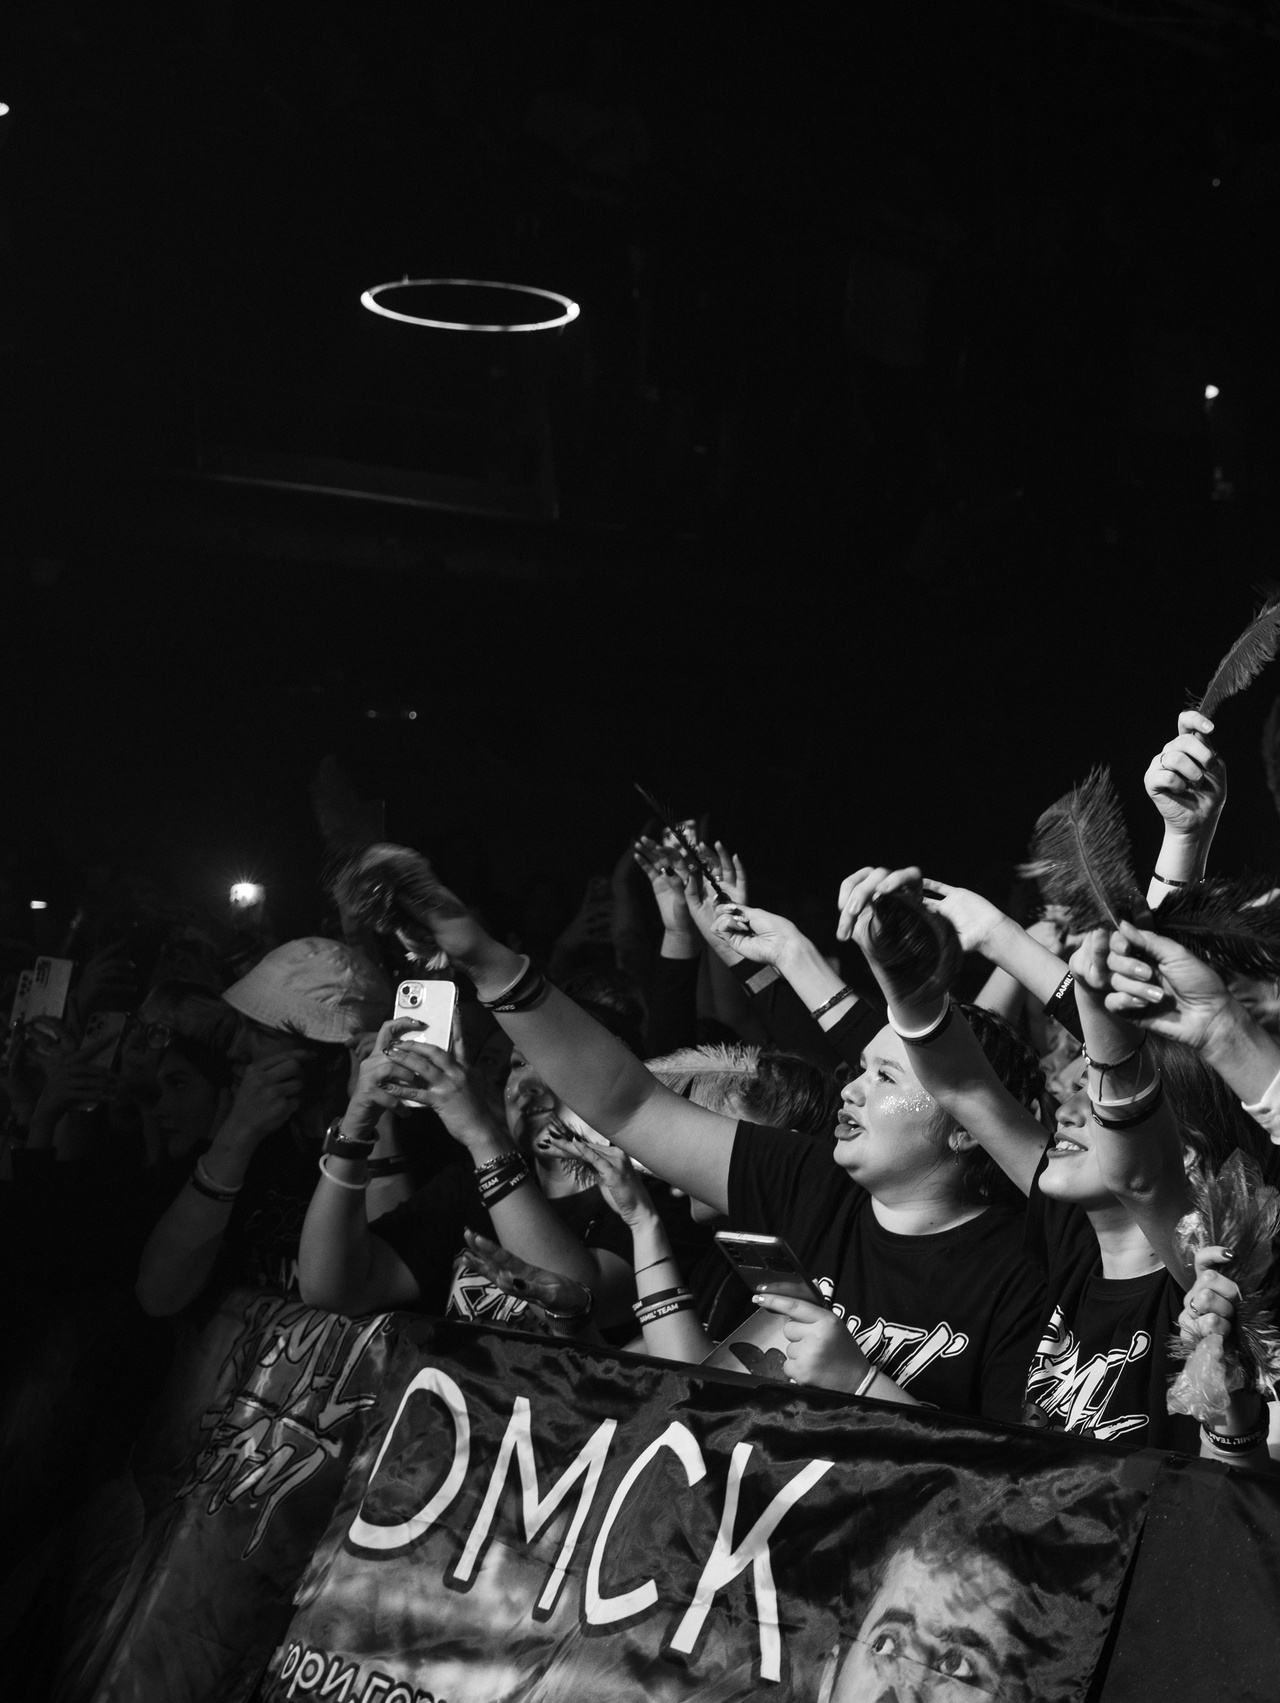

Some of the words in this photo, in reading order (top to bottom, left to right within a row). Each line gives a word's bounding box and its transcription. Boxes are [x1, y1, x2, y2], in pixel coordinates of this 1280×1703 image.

[1055, 973, 1074, 999] RAMIL'
[481, 1176, 499, 1190] TEAM
[656, 1302, 679, 1316] TEAM
[1208, 1430, 1232, 1445] TEAM
[1233, 1430, 1262, 1445] RAMIL'
[349, 1366, 836, 1683] ОМСК
